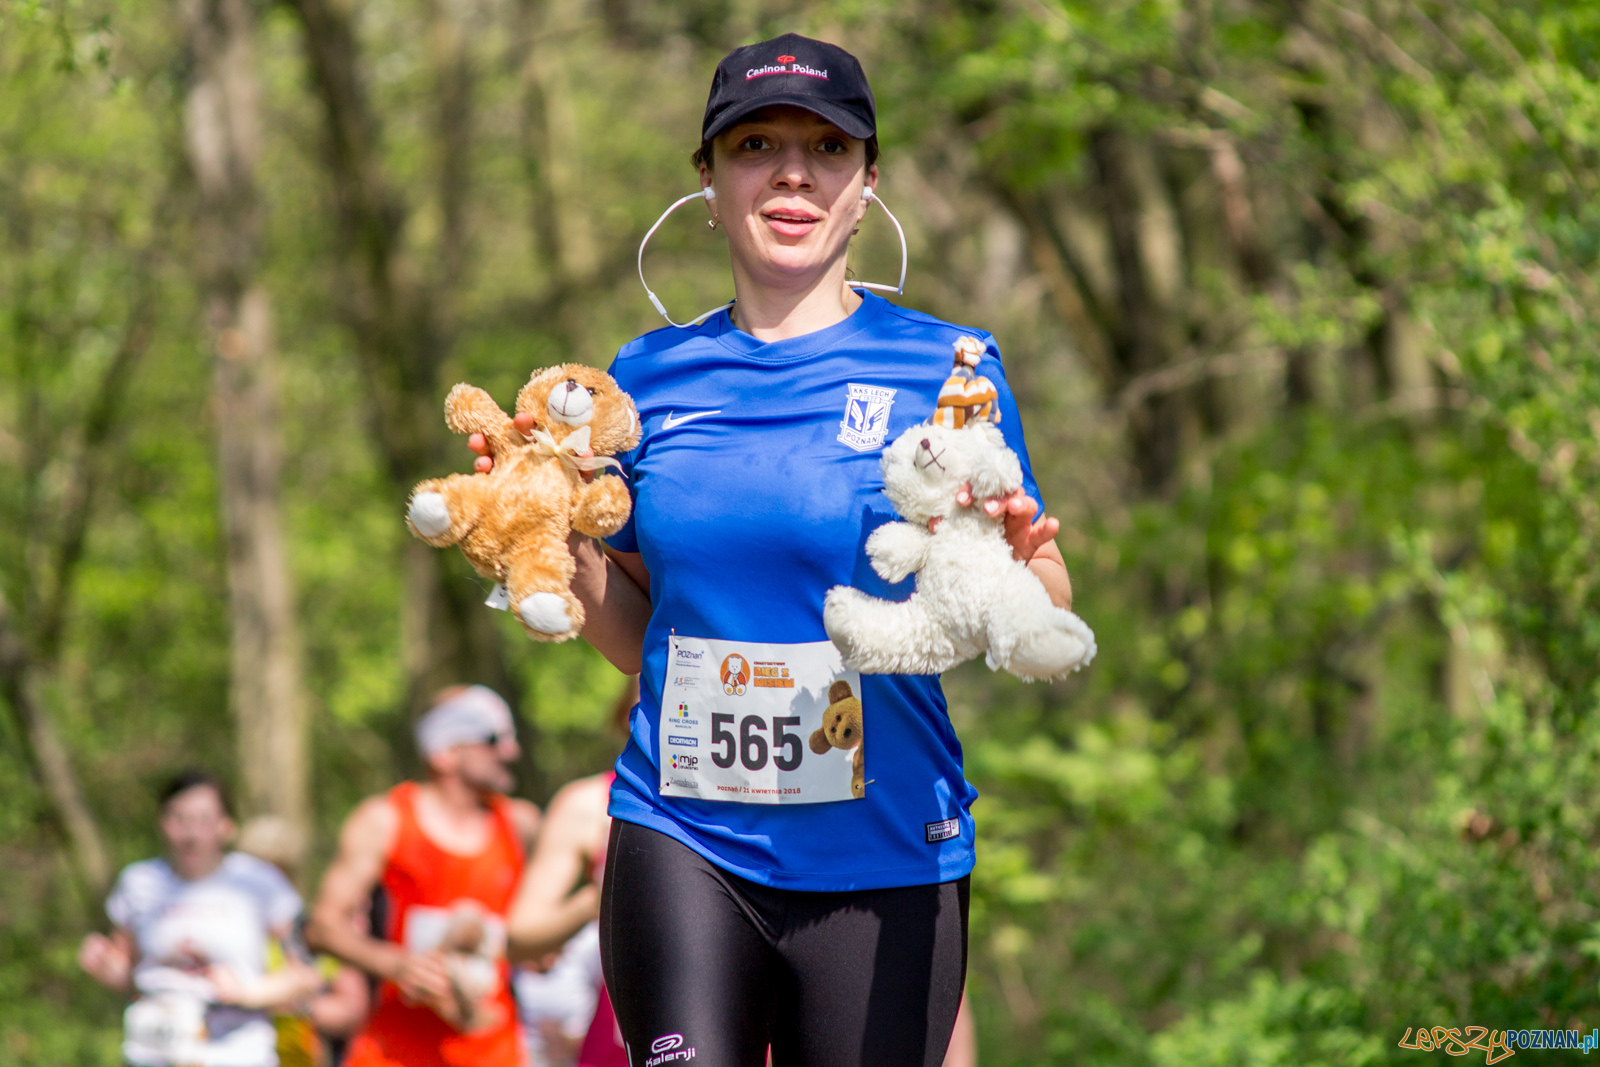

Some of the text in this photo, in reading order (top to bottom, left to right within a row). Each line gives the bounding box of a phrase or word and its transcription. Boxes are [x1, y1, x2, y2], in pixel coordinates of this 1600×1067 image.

[746, 63, 828, 78] Casinos Poland
[711, 712, 803, 772] 565
[679, 754, 699, 767] mjp
[743, 786, 750, 794] 21
